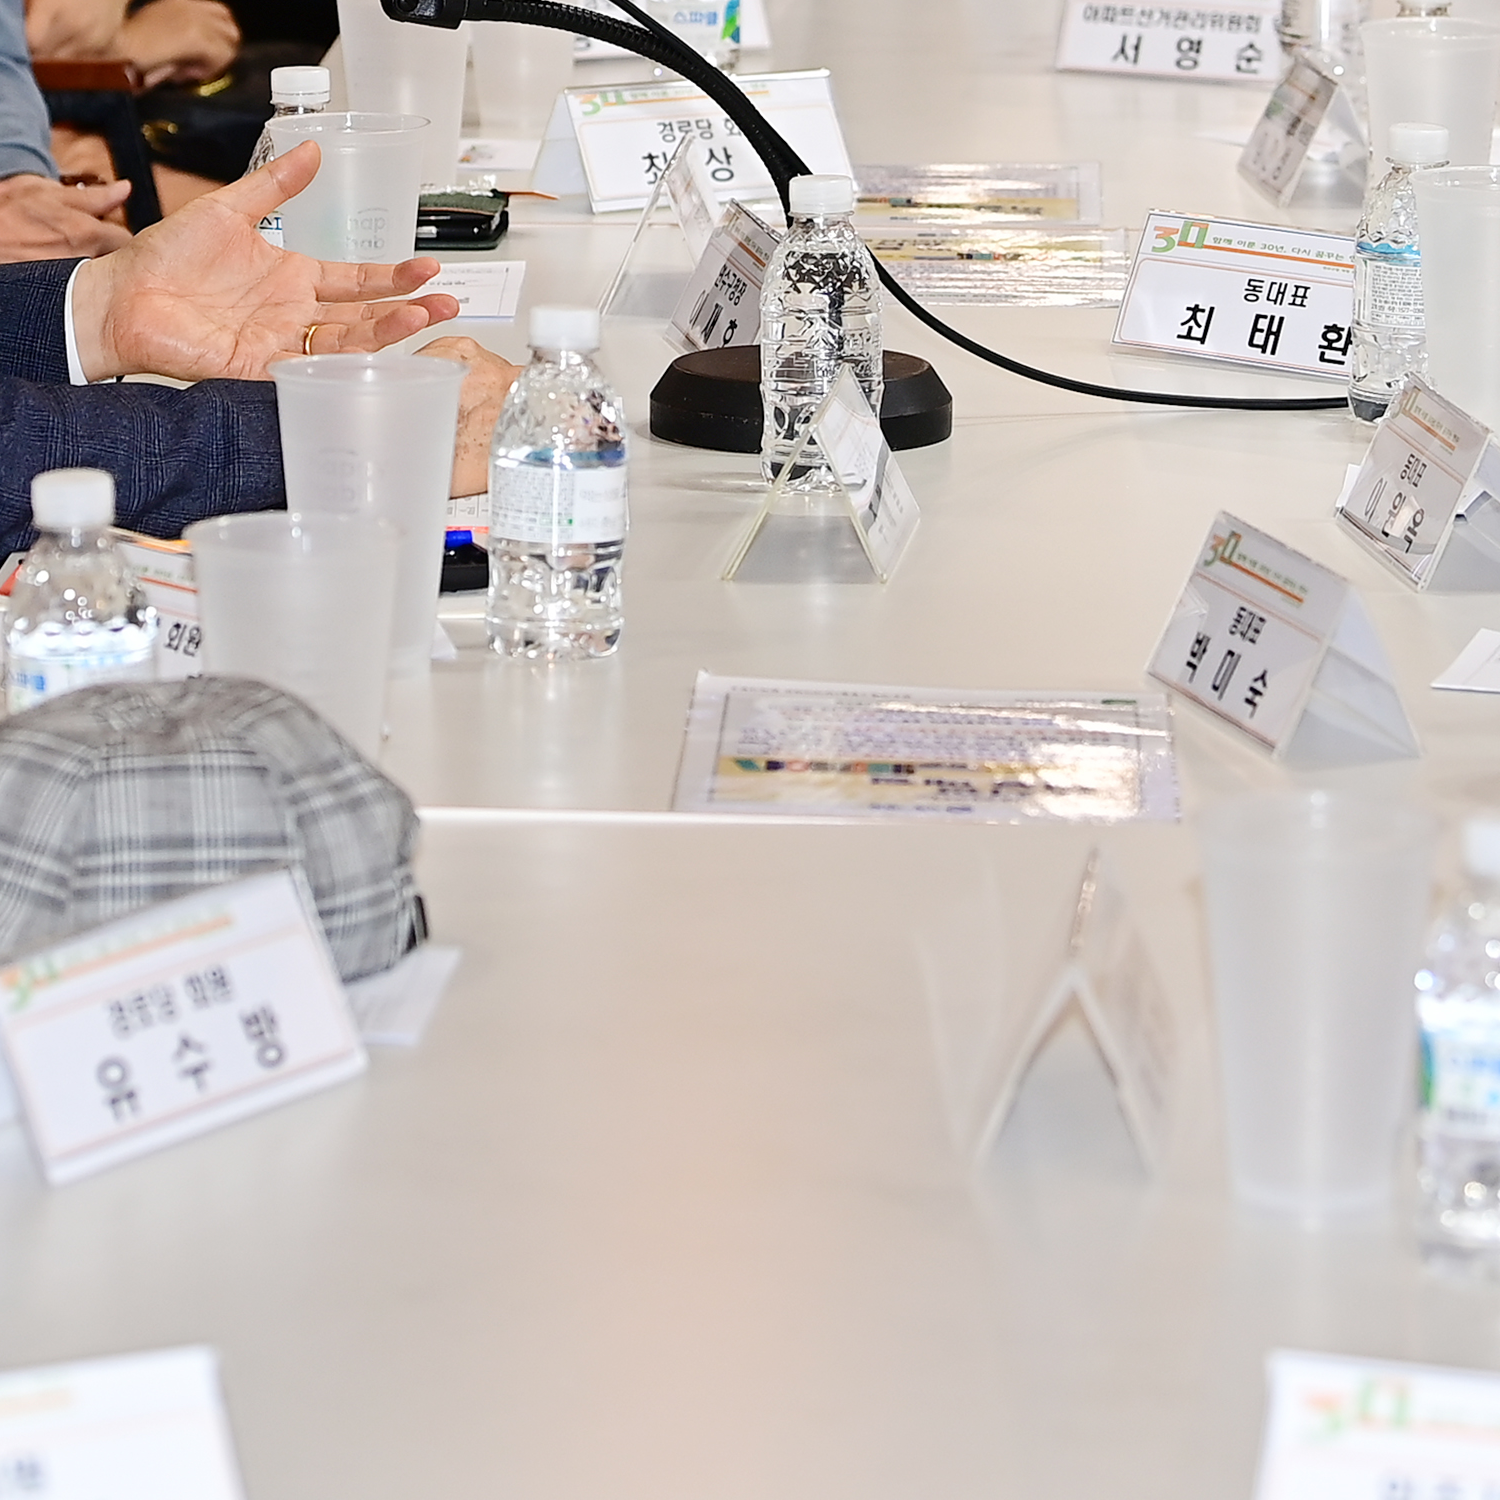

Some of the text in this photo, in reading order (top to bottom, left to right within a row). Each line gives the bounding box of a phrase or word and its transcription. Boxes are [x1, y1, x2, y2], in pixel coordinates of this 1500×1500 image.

[656, 118, 714, 144] 경로당
[1241, 277, 1312, 308] 동대표
[1399, 452, 1428, 489] 동대표
[1228, 605, 1268, 645] 동대표
